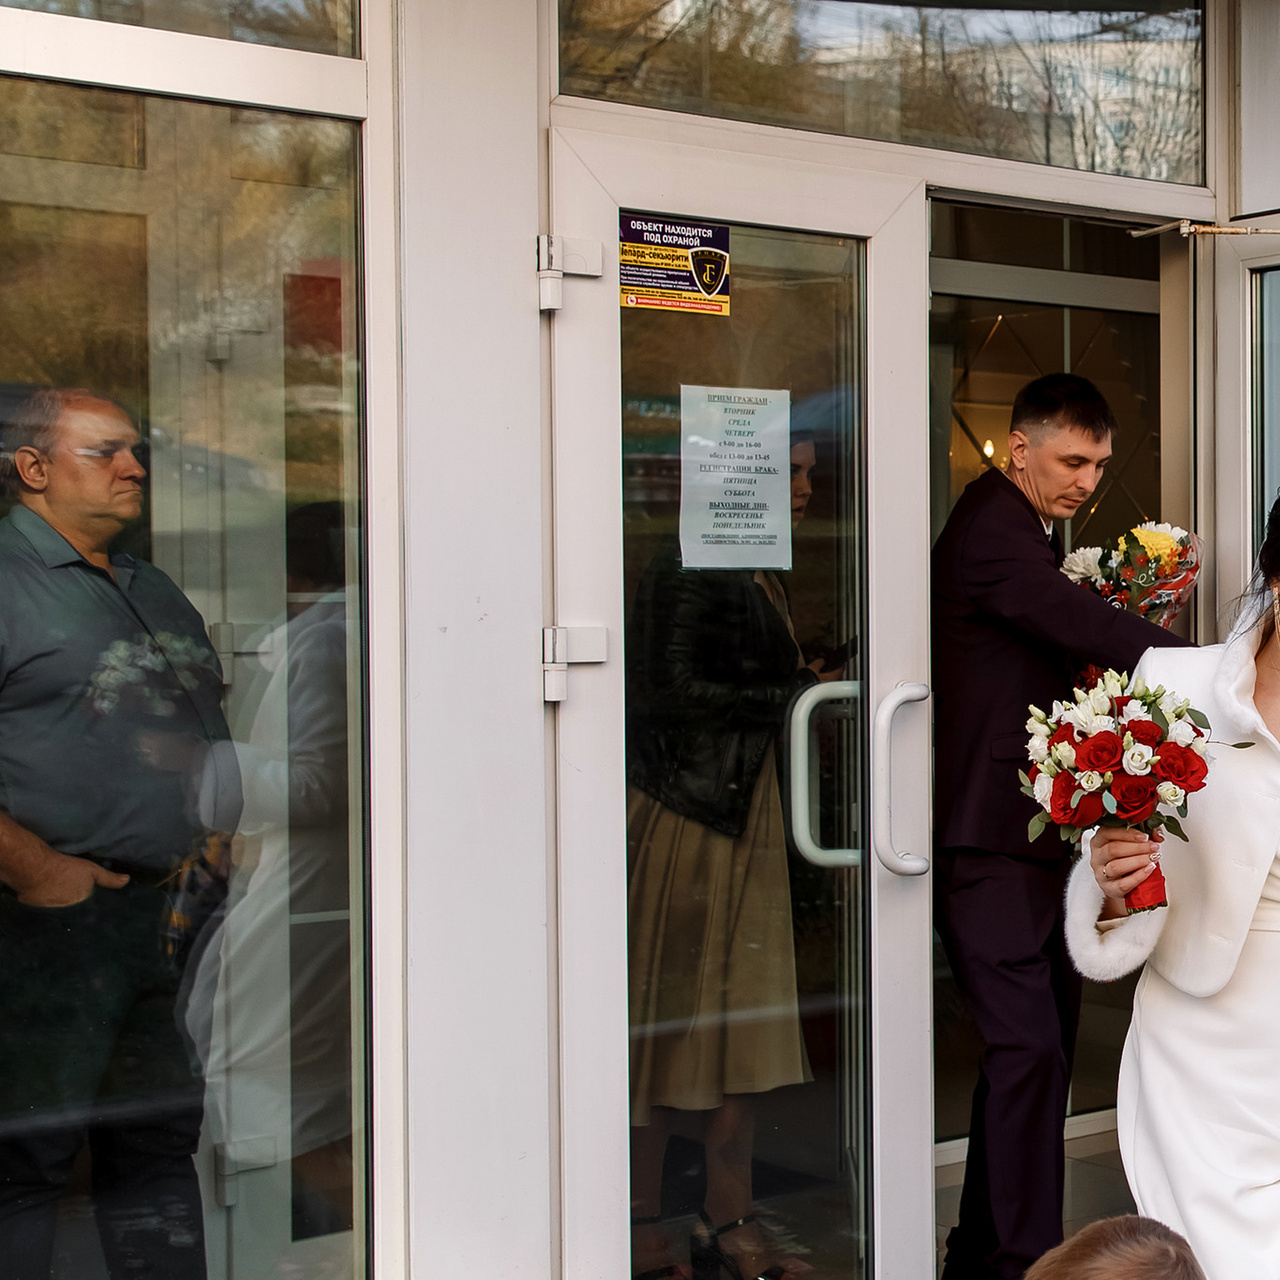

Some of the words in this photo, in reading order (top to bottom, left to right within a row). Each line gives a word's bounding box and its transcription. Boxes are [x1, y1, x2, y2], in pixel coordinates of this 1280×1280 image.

[630, 220, 663, 233] ОБЪЕКТ
[664, 224, 713, 238] НАХОДИТСЯ
[643, 232, 662, 243] ПОД
[662, 234, 700, 246] ОХРАНОЙ
[707, 394, 732, 403] ПРИЕМ
[733, 396, 768, 405] ГРАЖДАН
[723, 407, 757, 416] ВТОРНИК
[699, 464, 752, 473] РЕГИСТРАЦИЯ
[724, 489, 756, 497] СУББОТА
[709, 502, 751, 510] ВЫХОДНЫЕ
